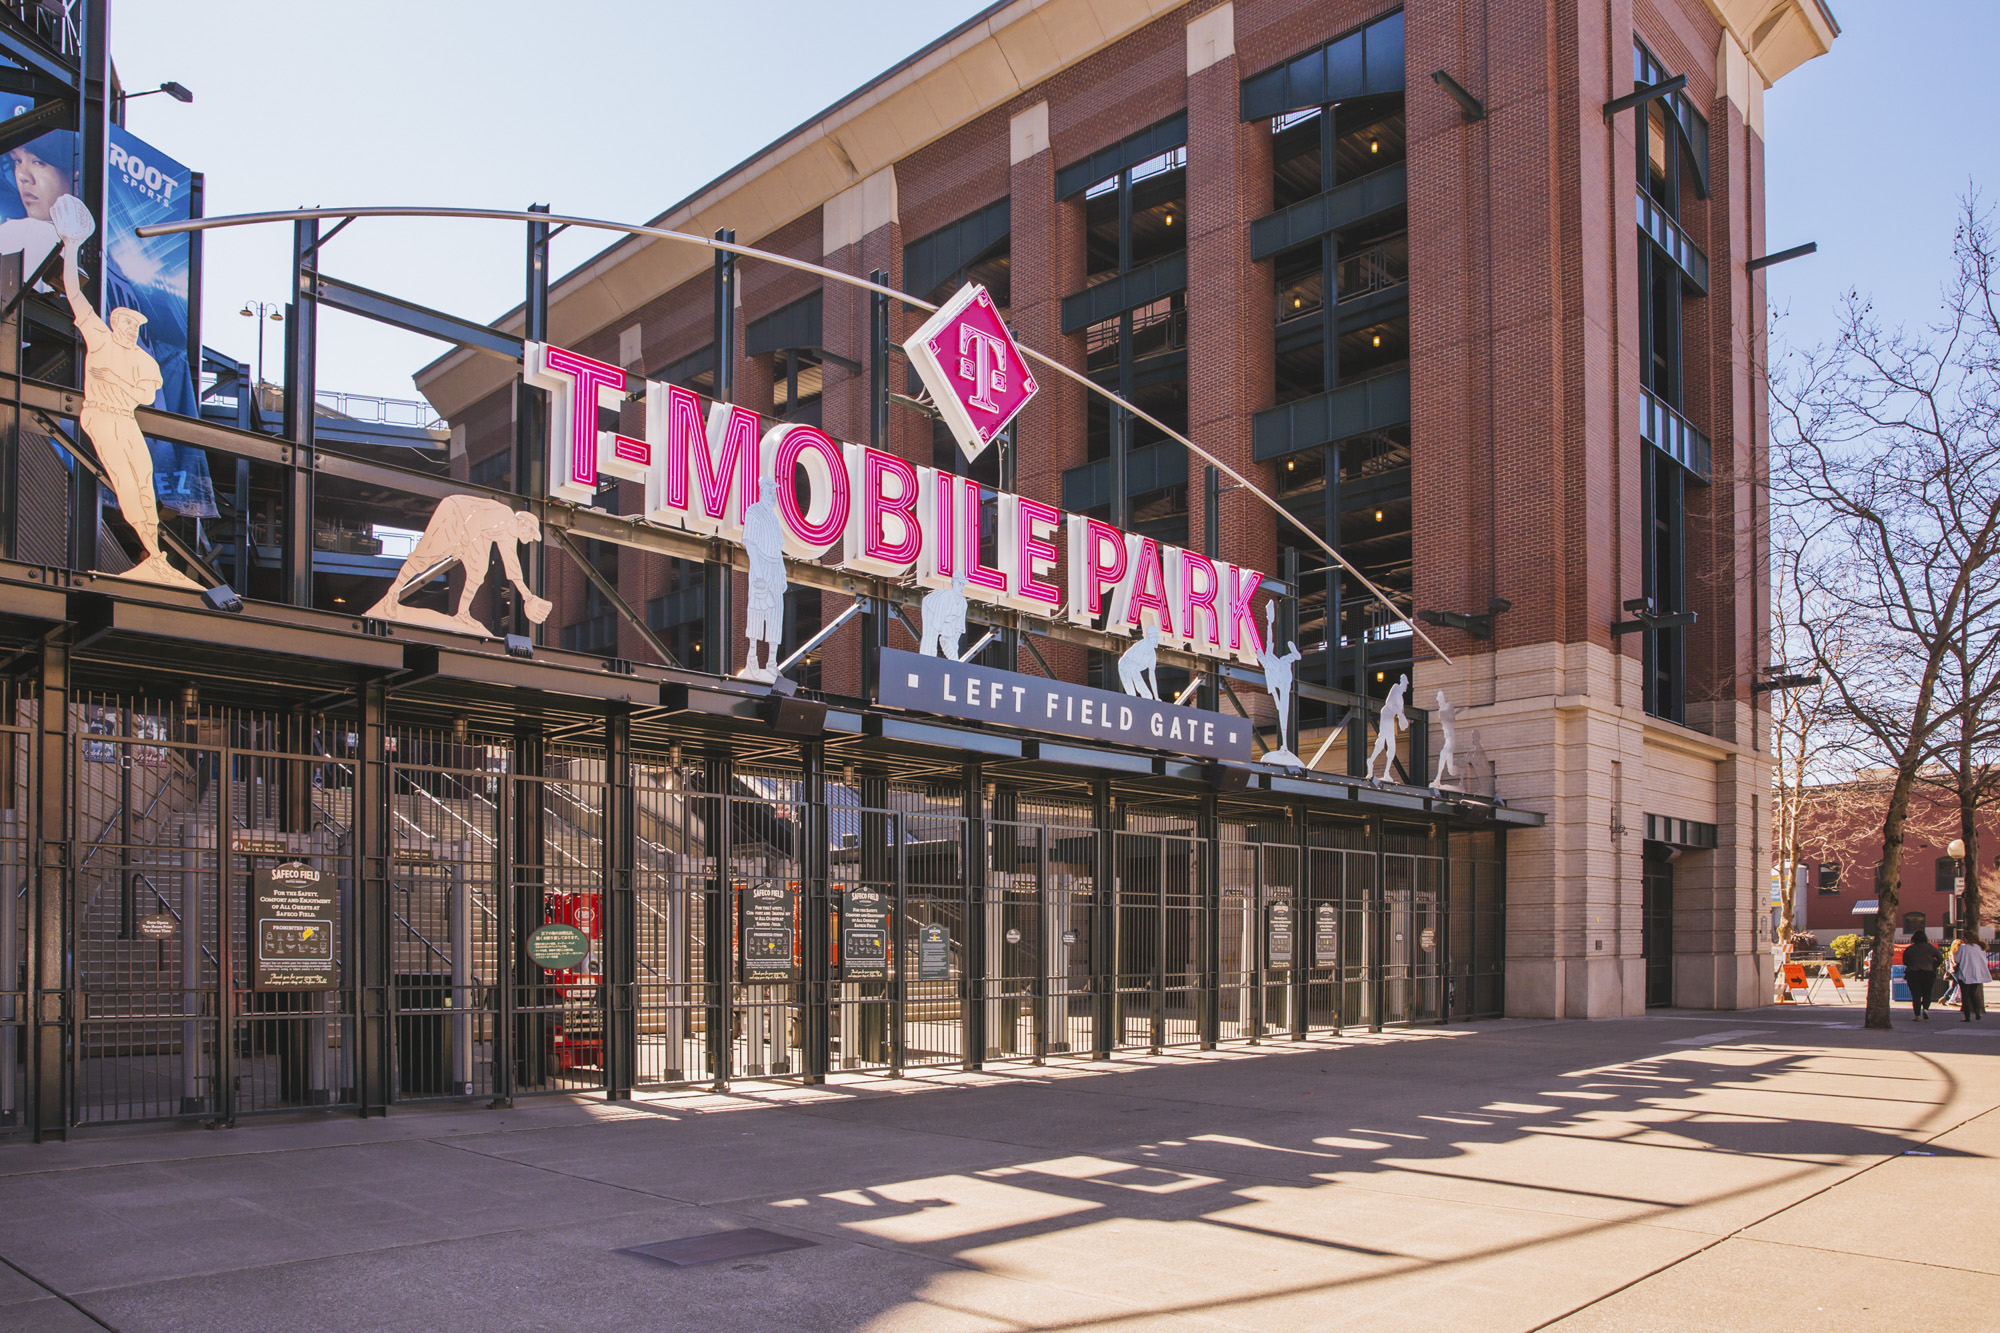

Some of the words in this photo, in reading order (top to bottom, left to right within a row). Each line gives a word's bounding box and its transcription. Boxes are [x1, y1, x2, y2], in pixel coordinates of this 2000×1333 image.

[109, 142, 178, 200] ROOT
[122, 174, 171, 208] SPORTS
[959, 323, 1007, 415] T
[526, 340, 1062, 613] T-MOBILE
[1070, 514, 1265, 663] PARK
[943, 673, 1026, 713] LEFT
[1046, 692, 1133, 732] FIELD
[1150, 712, 1215, 746] GATE
[271, 869, 299, 880] SAFECO
[300, 870, 320, 882] FIELD
[753, 889, 771, 898] SAFECO
[771, 889, 784, 899] FIELD
[852, 892, 867, 901] SAFECO
[867, 893, 879, 902] FIELD
